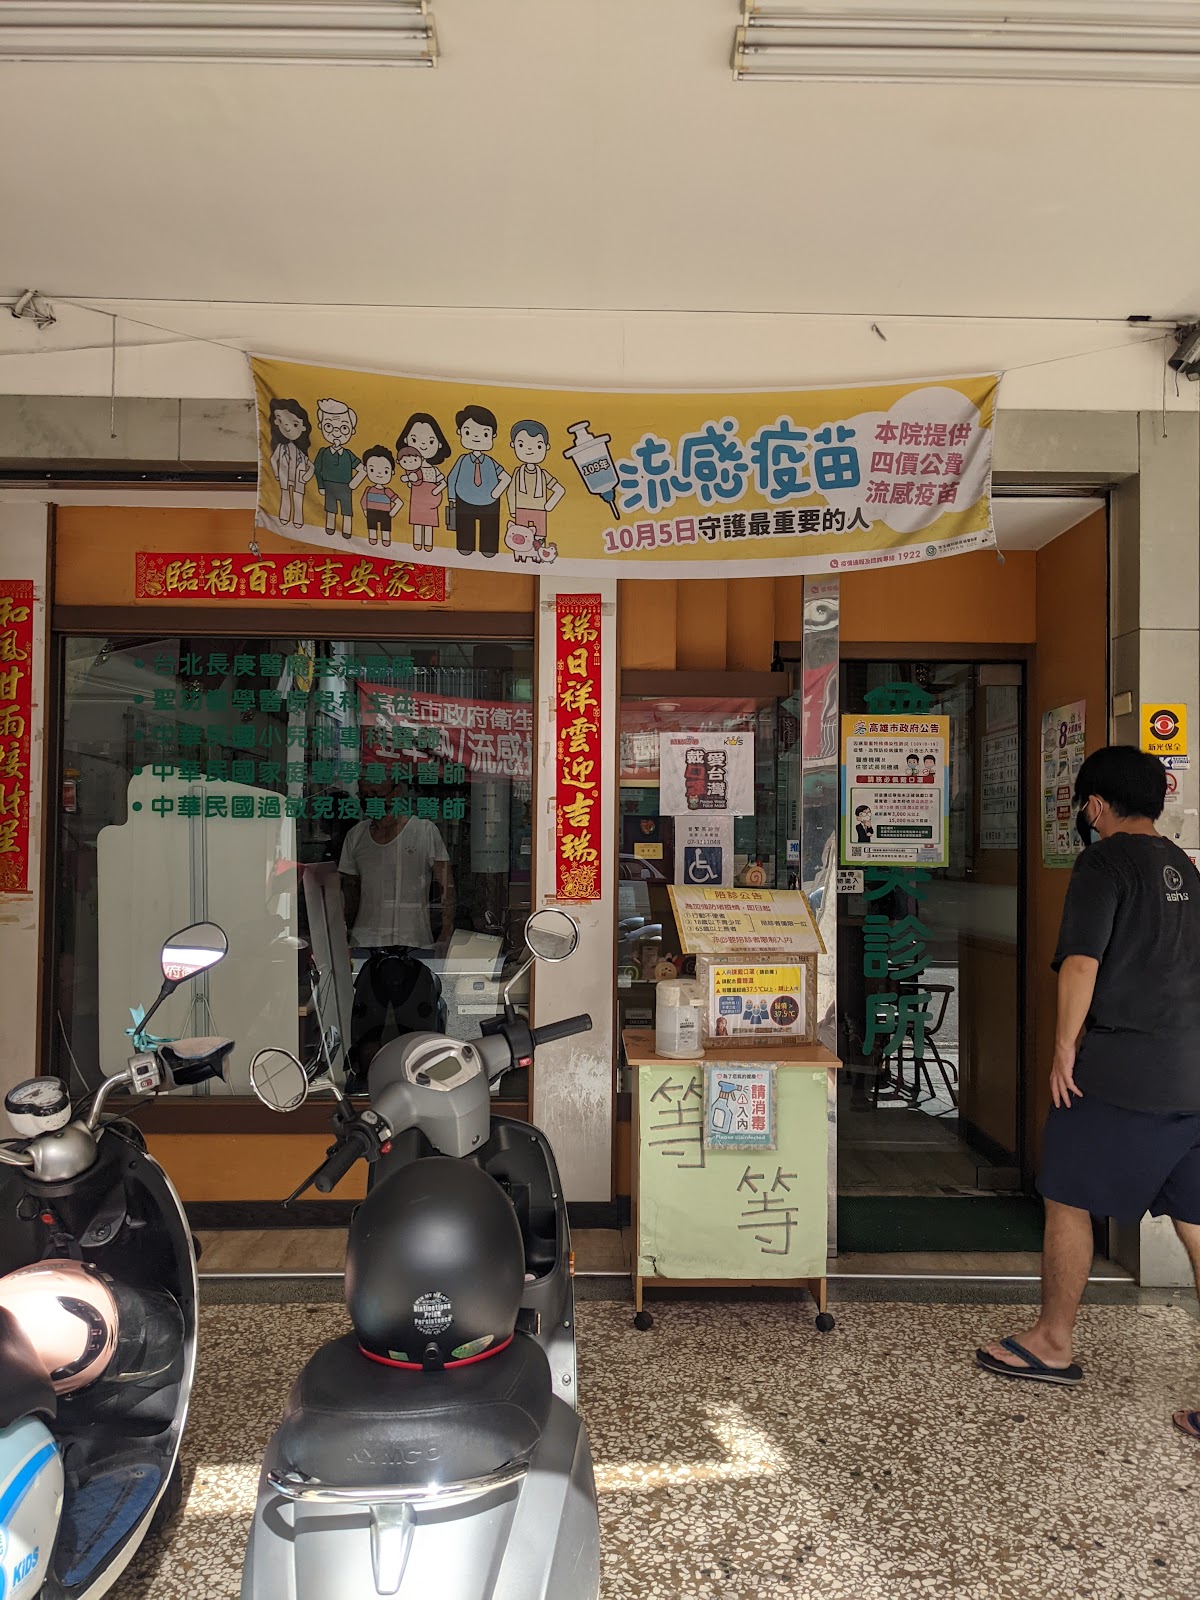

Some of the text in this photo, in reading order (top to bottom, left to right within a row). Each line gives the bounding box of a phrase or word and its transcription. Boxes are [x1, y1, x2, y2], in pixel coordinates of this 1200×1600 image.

[874, 420, 971, 447] 本院提供
[582, 459, 610, 476] 109年
[619, 420, 860, 510] 流感疫苗
[869, 452, 963, 476] 四價公費
[864, 481, 960, 506] 流感疫苗
[898, 550, 921, 561] 1922
[869, 723, 939, 734] 高雄市政府公告
[707, 752, 726, 796] 愛台灣
[151, 795, 465, 820] 中華民國過敏免疫專科醫師
[714, 890, 763, 900] 陪診公告
[737, 1106, 749, 1131] 入內
[751, 1084, 766, 1131] 請消毒
[648, 1076, 705, 1168] 等
[736, 1165, 799, 1255] 等
